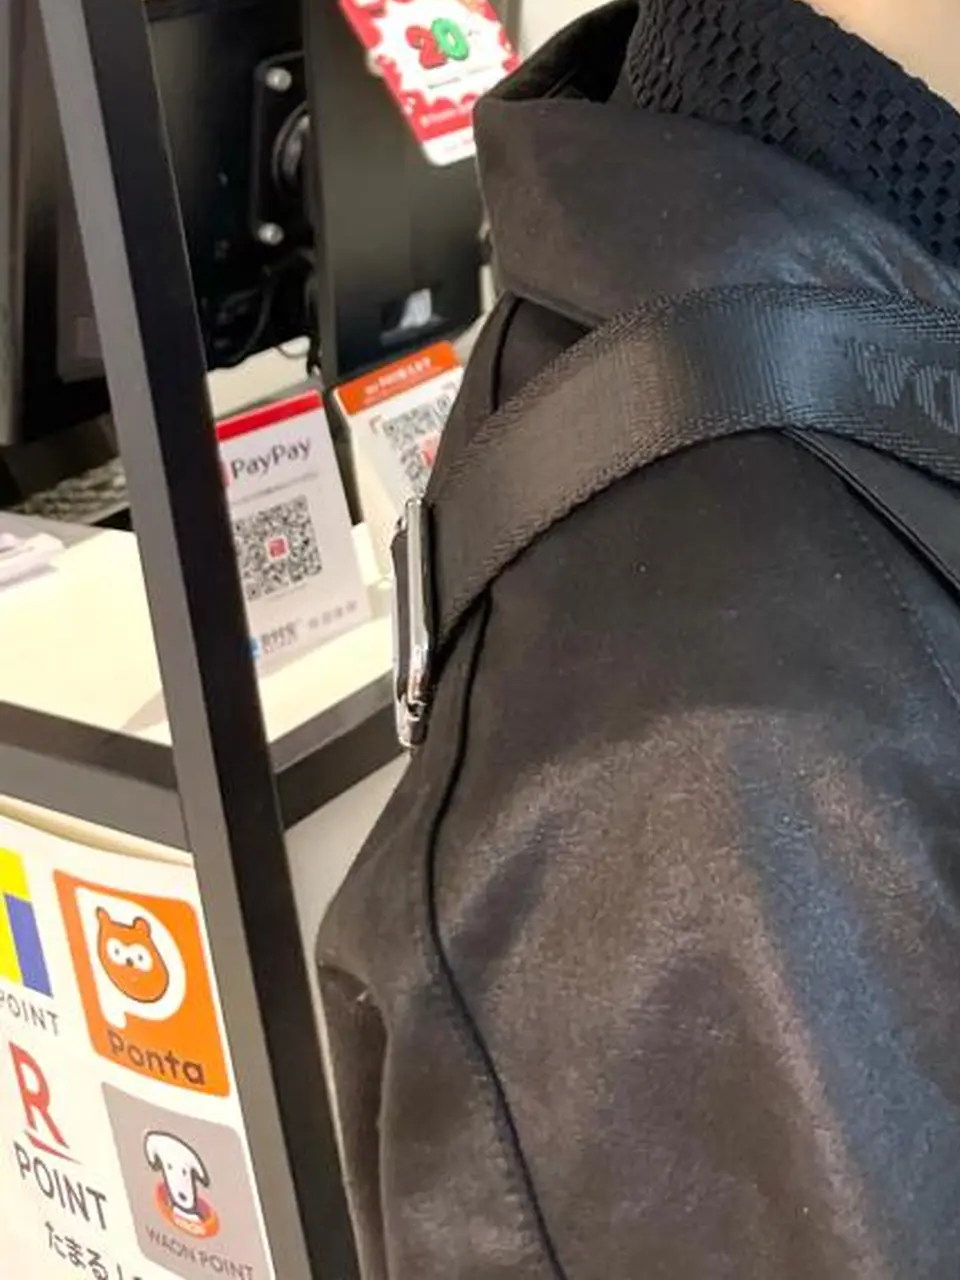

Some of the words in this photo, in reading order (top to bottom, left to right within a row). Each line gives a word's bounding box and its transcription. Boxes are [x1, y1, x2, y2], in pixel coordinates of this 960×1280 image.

[405, 18, 469, 70] 20
[230, 437, 312, 480] PayPay
[106, 1029, 206, 1087] Ponta
[8, 1041, 70, 1150] R
[13, 1140, 107, 1230] POINT
[45, 1220, 142, 1280] たまる
[198, 1250, 254, 1280] POINT
